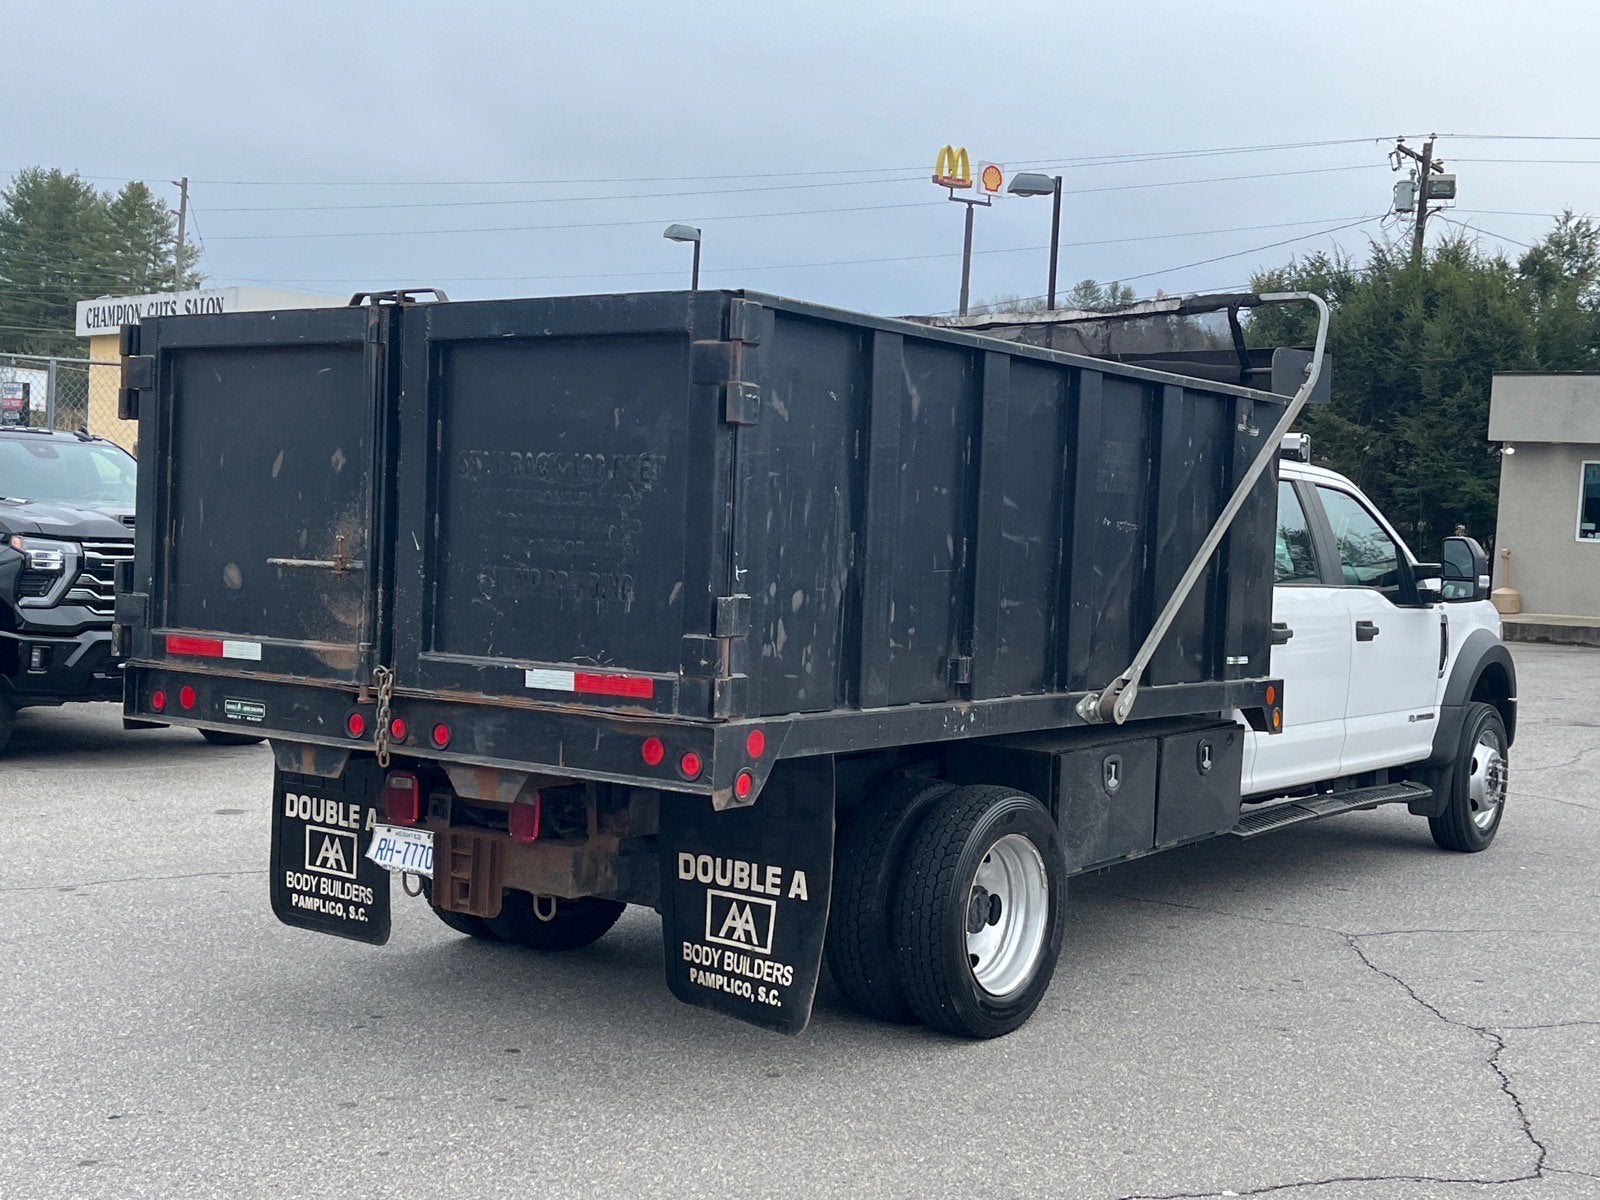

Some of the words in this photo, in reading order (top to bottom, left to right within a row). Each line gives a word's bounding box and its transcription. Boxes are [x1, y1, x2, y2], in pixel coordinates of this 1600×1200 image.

[86, 303, 142, 329] CHAMPION
[147, 300, 177, 316] CUTS
[185, 297, 224, 315] SALON
[285, 792, 360, 830] DOUBLE
[365, 808, 378, 832] A
[374, 837, 434, 870] RH-7770
[286, 870, 318, 893] BODY
[320, 878, 374, 905] BUILDERS
[678, 852, 782, 896] DOUBLE
[788, 870, 808, 901] A
[292, 893, 347, 920] PAMPLICO,
[349, 905, 369, 923] S.C.
[682, 941, 722, 969] BODY
[723, 950, 794, 987] BUILDERS
[689, 967, 755, 1003] PAMPLICO,
[758, 985, 782, 1007] S.C.
